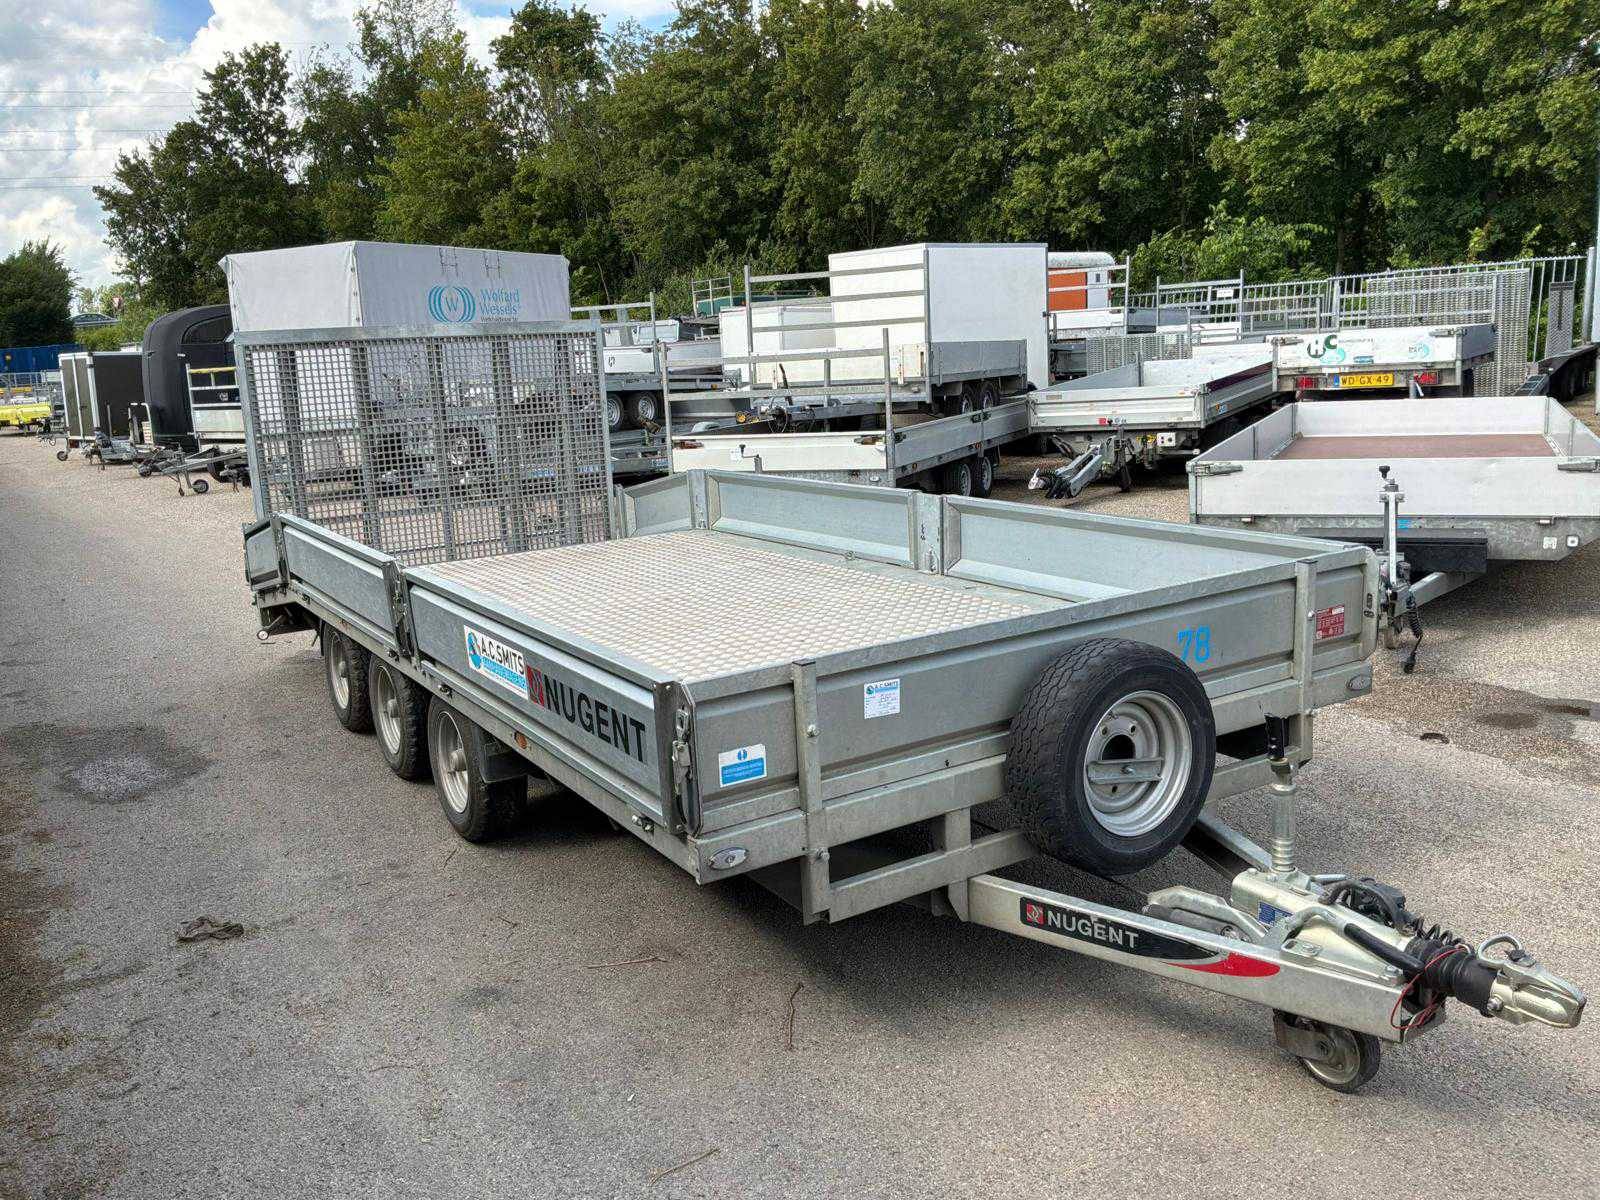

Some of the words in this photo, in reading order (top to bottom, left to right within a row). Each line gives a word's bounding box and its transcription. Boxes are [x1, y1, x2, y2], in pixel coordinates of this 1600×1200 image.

[480, 302, 518, 315] Wessels
[1177, 625, 1211, 664] 78
[543, 674, 646, 762] NUGENT
[1047, 910, 1139, 949] NUGENT
